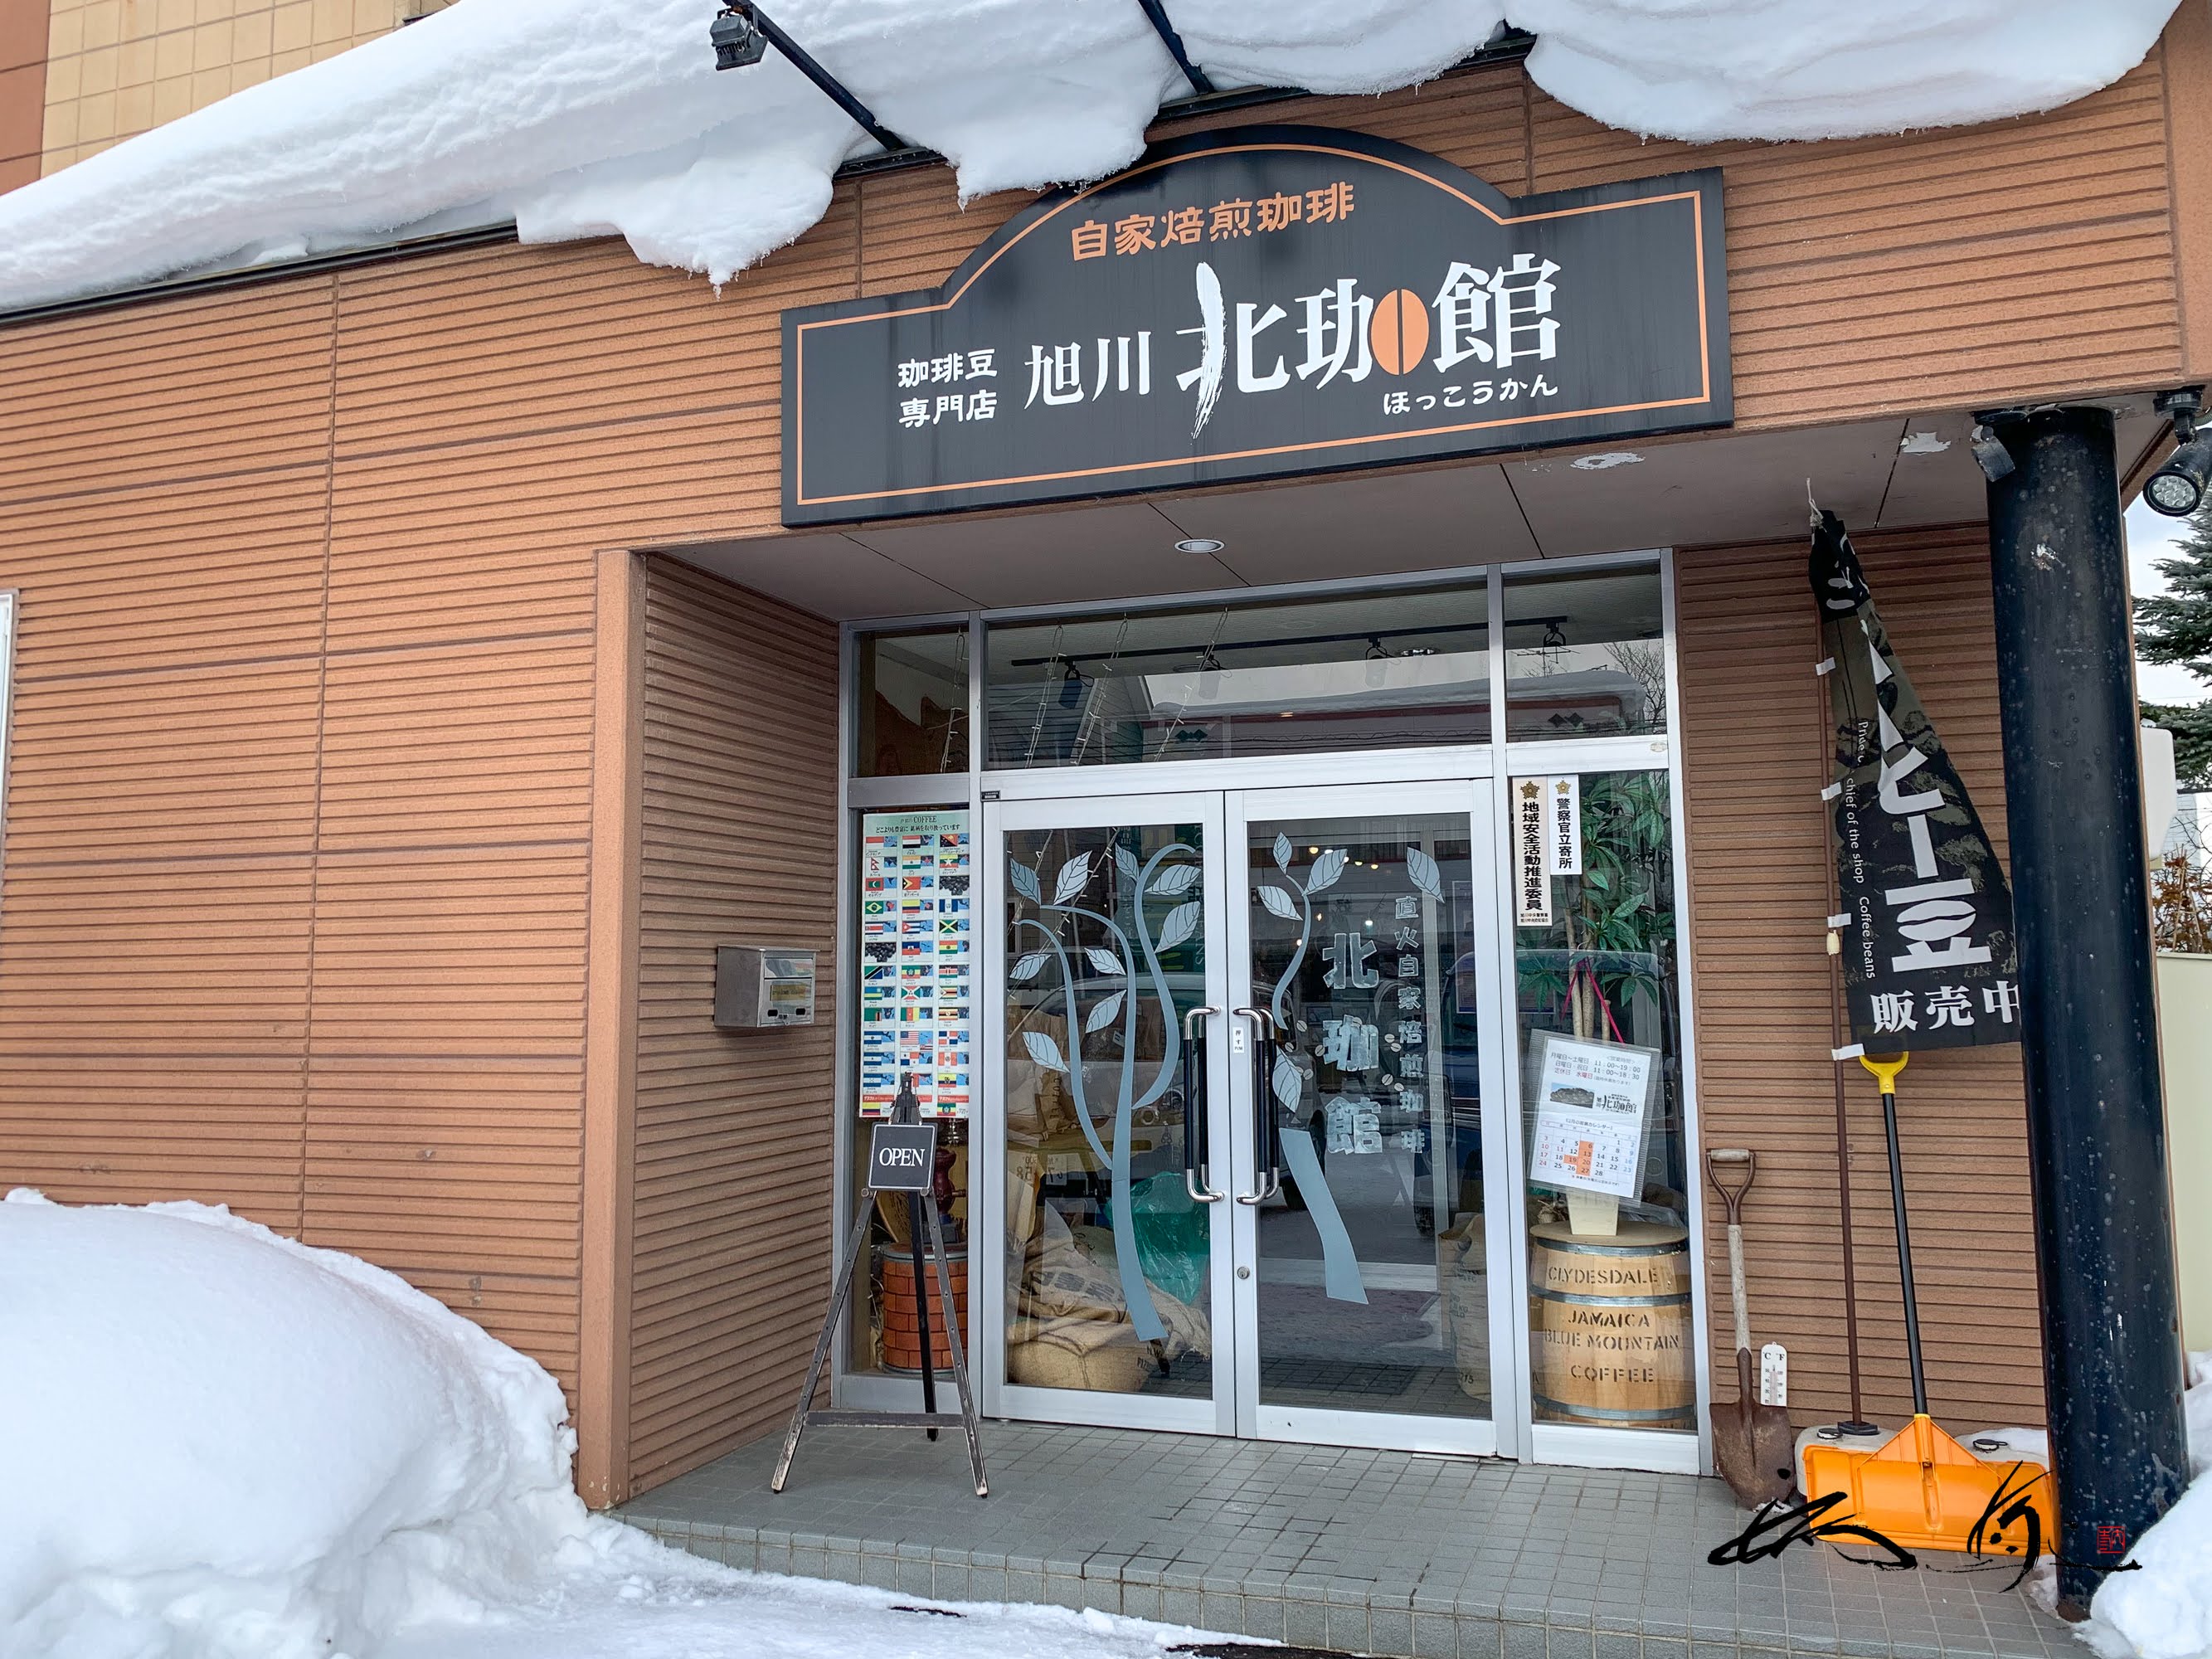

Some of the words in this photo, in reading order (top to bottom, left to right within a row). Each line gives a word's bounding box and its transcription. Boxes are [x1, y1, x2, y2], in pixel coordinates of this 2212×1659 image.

[1072, 181, 1356, 263] 自家焙煎珈琲
[1023, 332, 1151, 410] 旭川
[1176, 253, 1563, 439] 北珈館
[897, 352, 999, 389] 珈琲豆
[898, 390, 998, 429] 専門店
[1383, 375, 1559, 416] ほっこうかん
[1857, 721, 1869, 752] Pride
[1845, 777, 1858, 809] chief
[1556, 798, 1573, 869] 警察官立寄所
[1846, 811, 1859, 827] of
[1522, 801, 1543, 911] 地域安全活動推進委員
[1848, 828, 1860, 849] the
[1851, 853, 1864, 884] shop
[1859, 897, 1871, 937] Coffee
[1862, 941, 1876, 980] beans
[1393, 895, 1425, 1154] 直火自家焙煎珈琲
[1869, 980, 2020, 1034] 販売中
[1322, 932, 1383, 1155] 北珈館
[879, 1147, 926, 1167] OPEN
[1548, 1266, 1659, 1284] CLYDESDALE
[1568, 1310, 1650, 1327] JAMAICA
[1544, 1328, 1581, 1347] BLUE
[1587, 1334, 1680, 1351] MOUNTAIN
[1571, 1365, 1655, 1383] COFFEE
